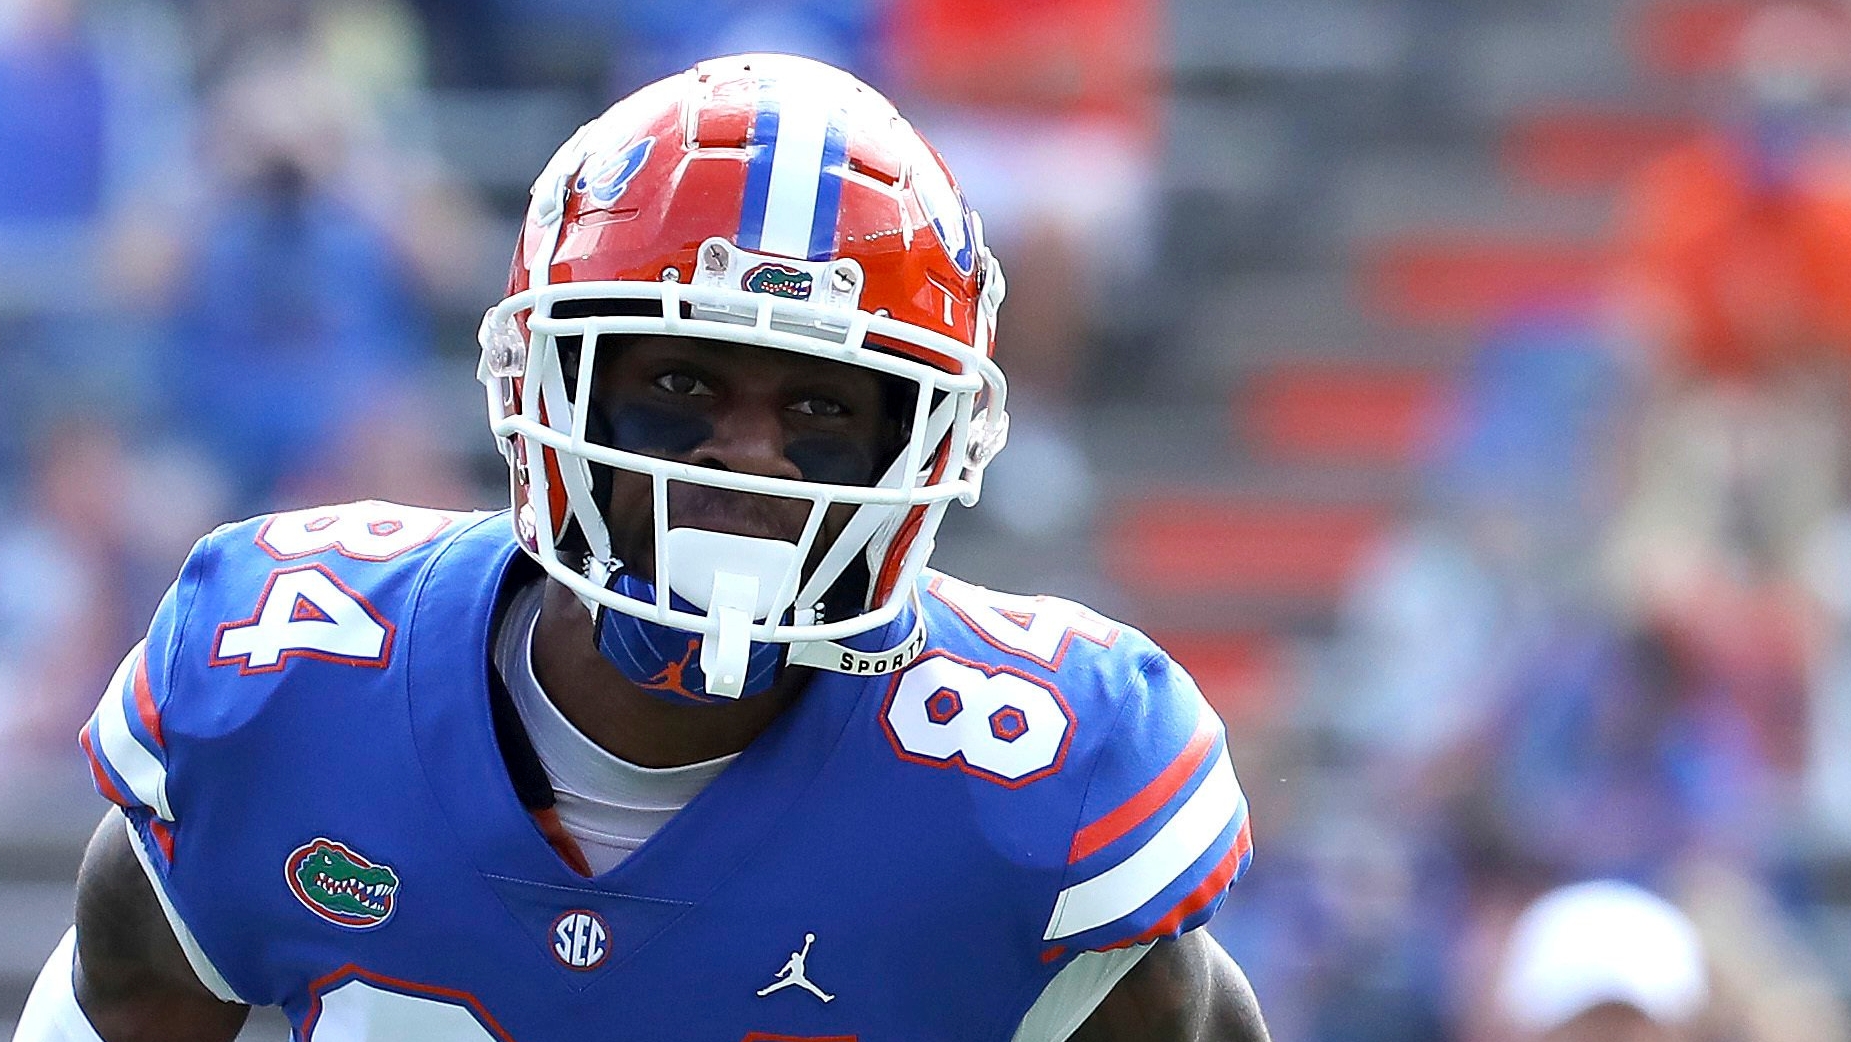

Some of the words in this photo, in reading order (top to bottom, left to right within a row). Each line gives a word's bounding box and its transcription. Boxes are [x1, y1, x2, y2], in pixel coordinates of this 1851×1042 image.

[210, 499, 452, 675] 84
[878, 573, 1119, 790] 84
[554, 913, 606, 967] SEC
